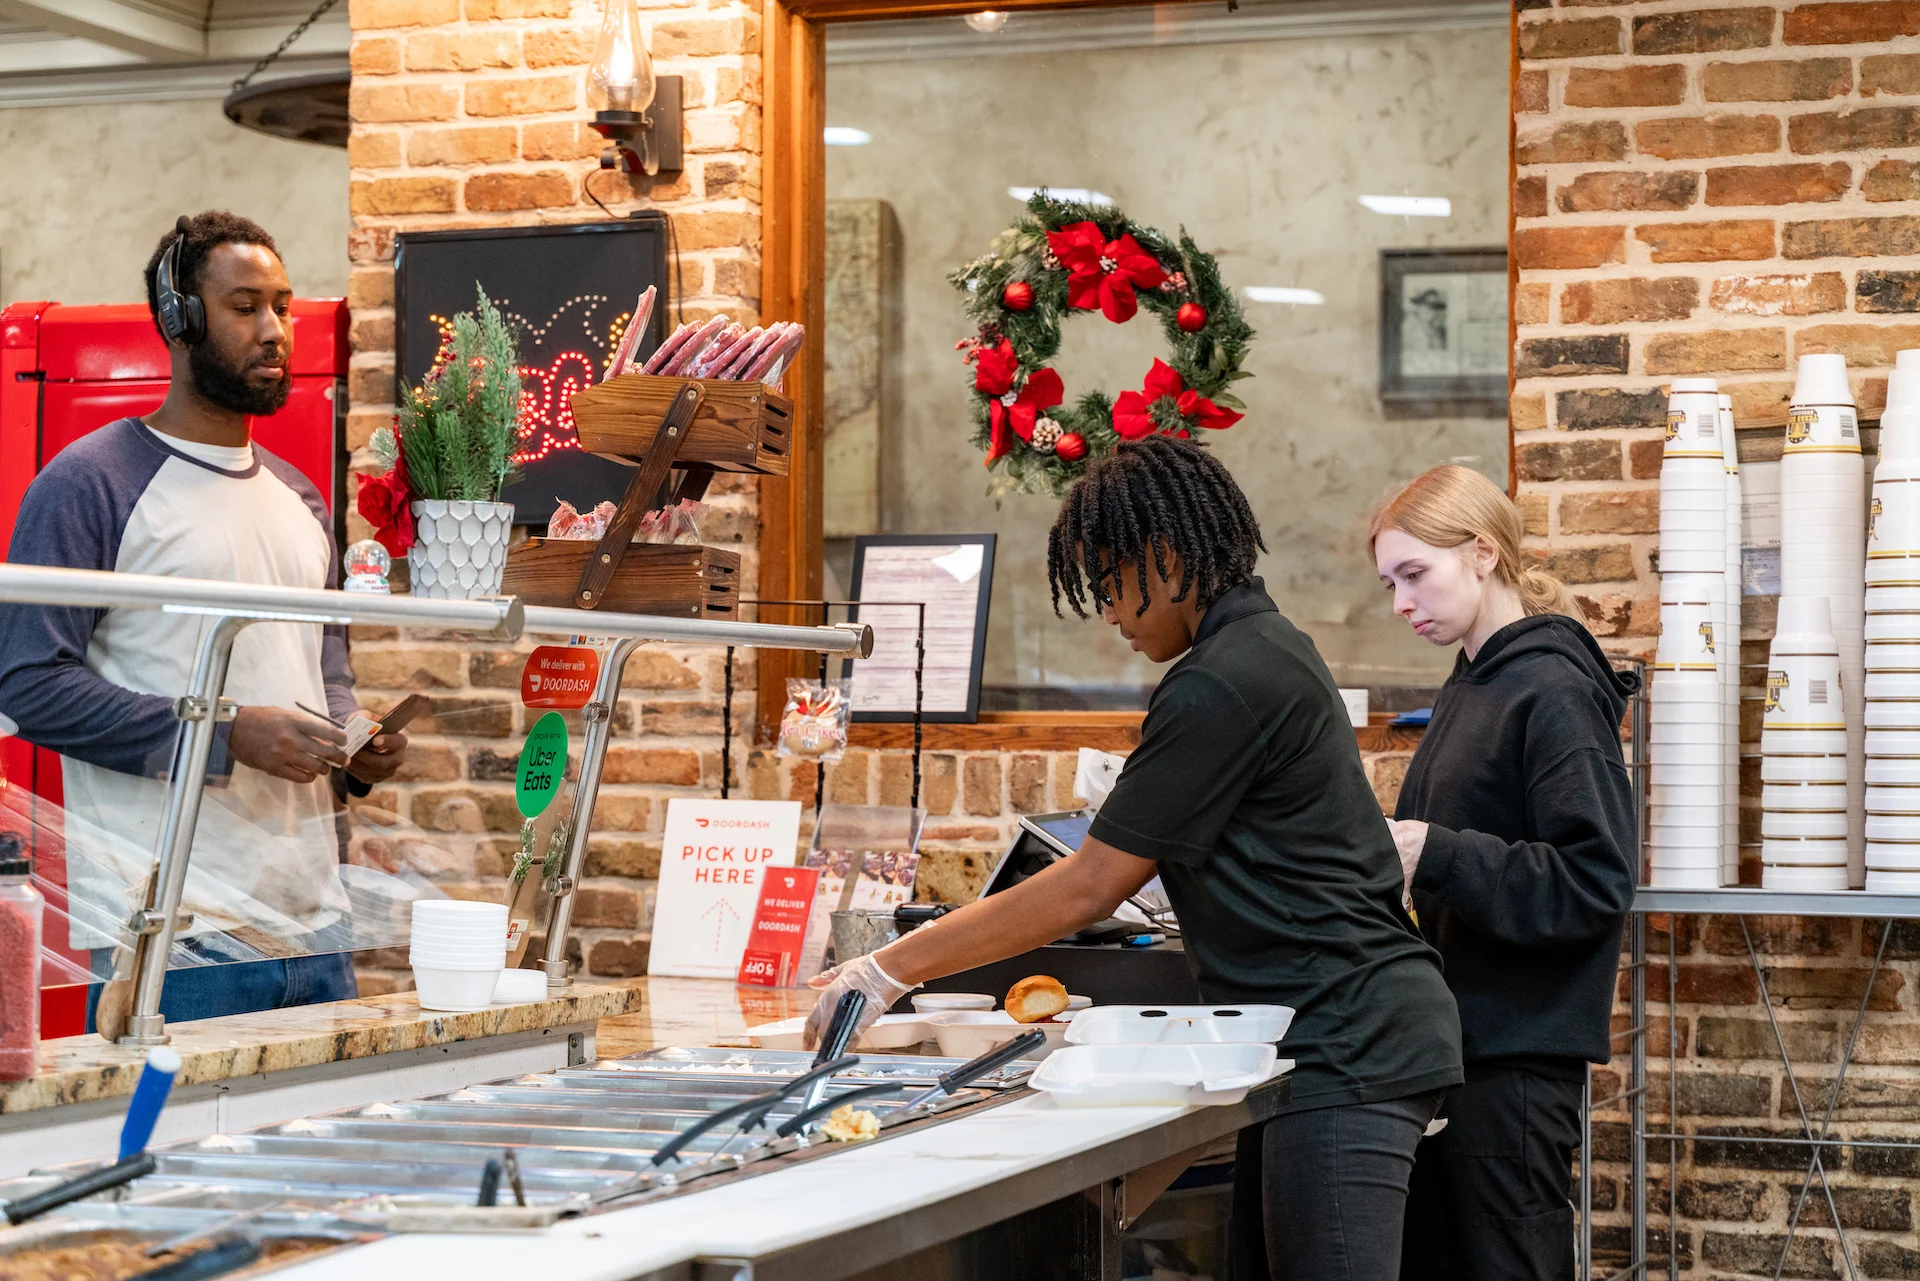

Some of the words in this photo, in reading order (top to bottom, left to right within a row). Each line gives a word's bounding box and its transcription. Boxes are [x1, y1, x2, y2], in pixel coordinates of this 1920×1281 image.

[541, 658, 551, 670] We
[551, 659, 572, 670] deliver
[572, 660, 586, 671] with
[542, 677, 590, 692] DOORDASH
[782, 721, 799, 736] Tea
[529, 746, 557, 767] Uber
[524, 770, 552, 791] Eats
[713, 820, 770, 829] DOORDASH
[682, 845, 735, 862] PICK
[744, 847, 773, 863] UP
[695, 868, 755, 884] HERE
[764, 898, 776, 907] WE
[776, 899, 805, 909] DELIVER
[758, 921, 801, 933] DOORDASH
[745, 961, 766, 975] OFF
